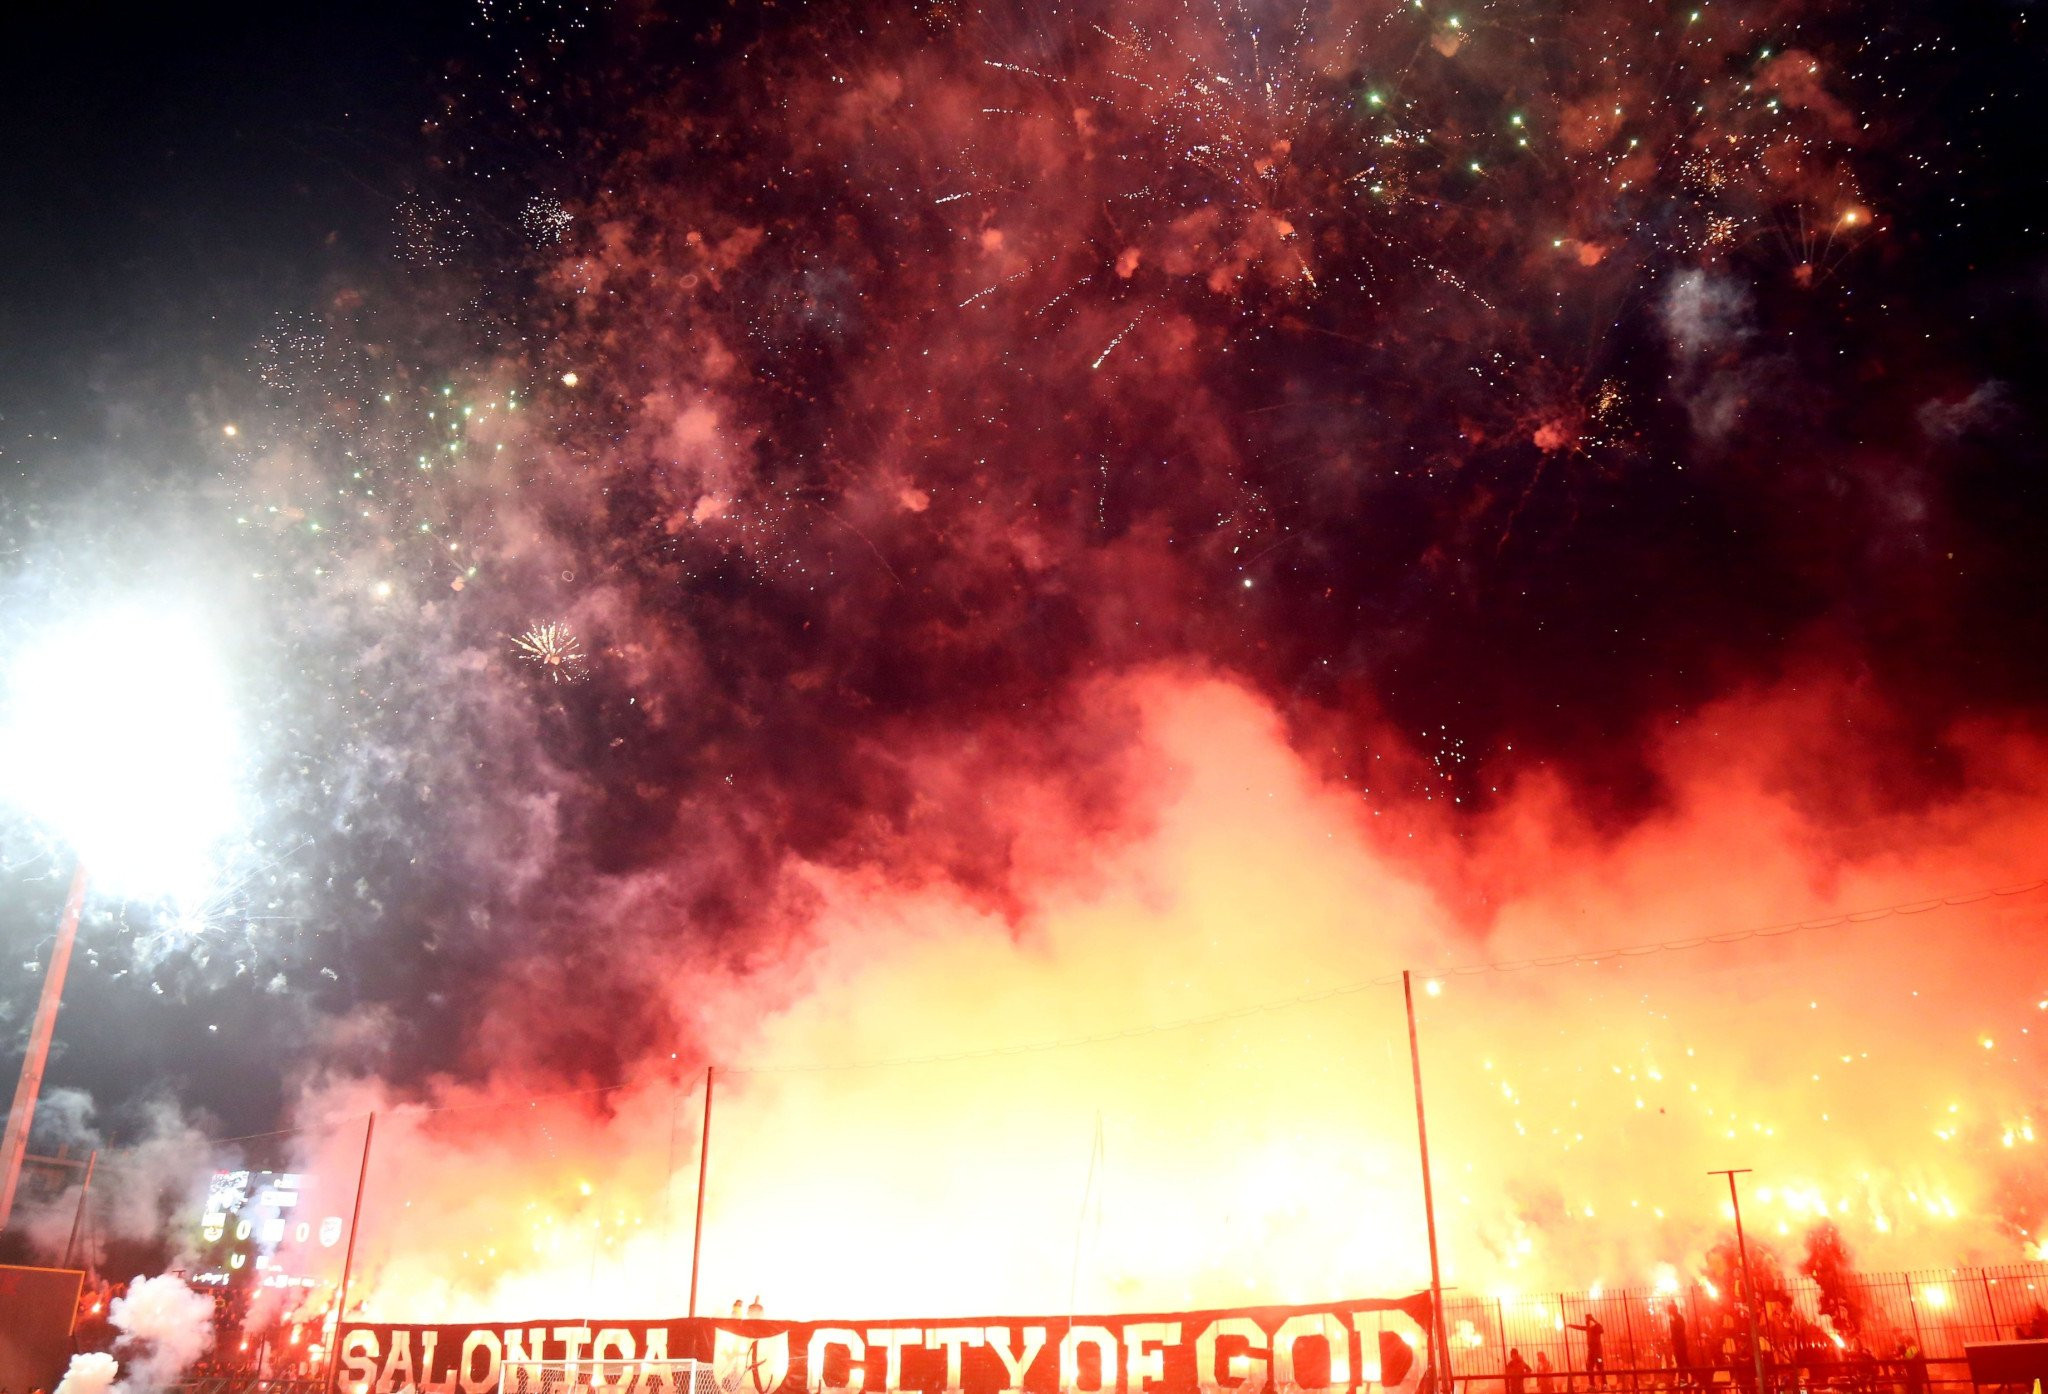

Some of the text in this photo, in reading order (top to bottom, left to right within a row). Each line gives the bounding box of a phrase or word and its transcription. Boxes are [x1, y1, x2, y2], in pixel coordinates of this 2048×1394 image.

[236, 1220, 310, 1243] 0 0
[339, 1309, 1429, 1394] SALONICA CITY OF GOD
